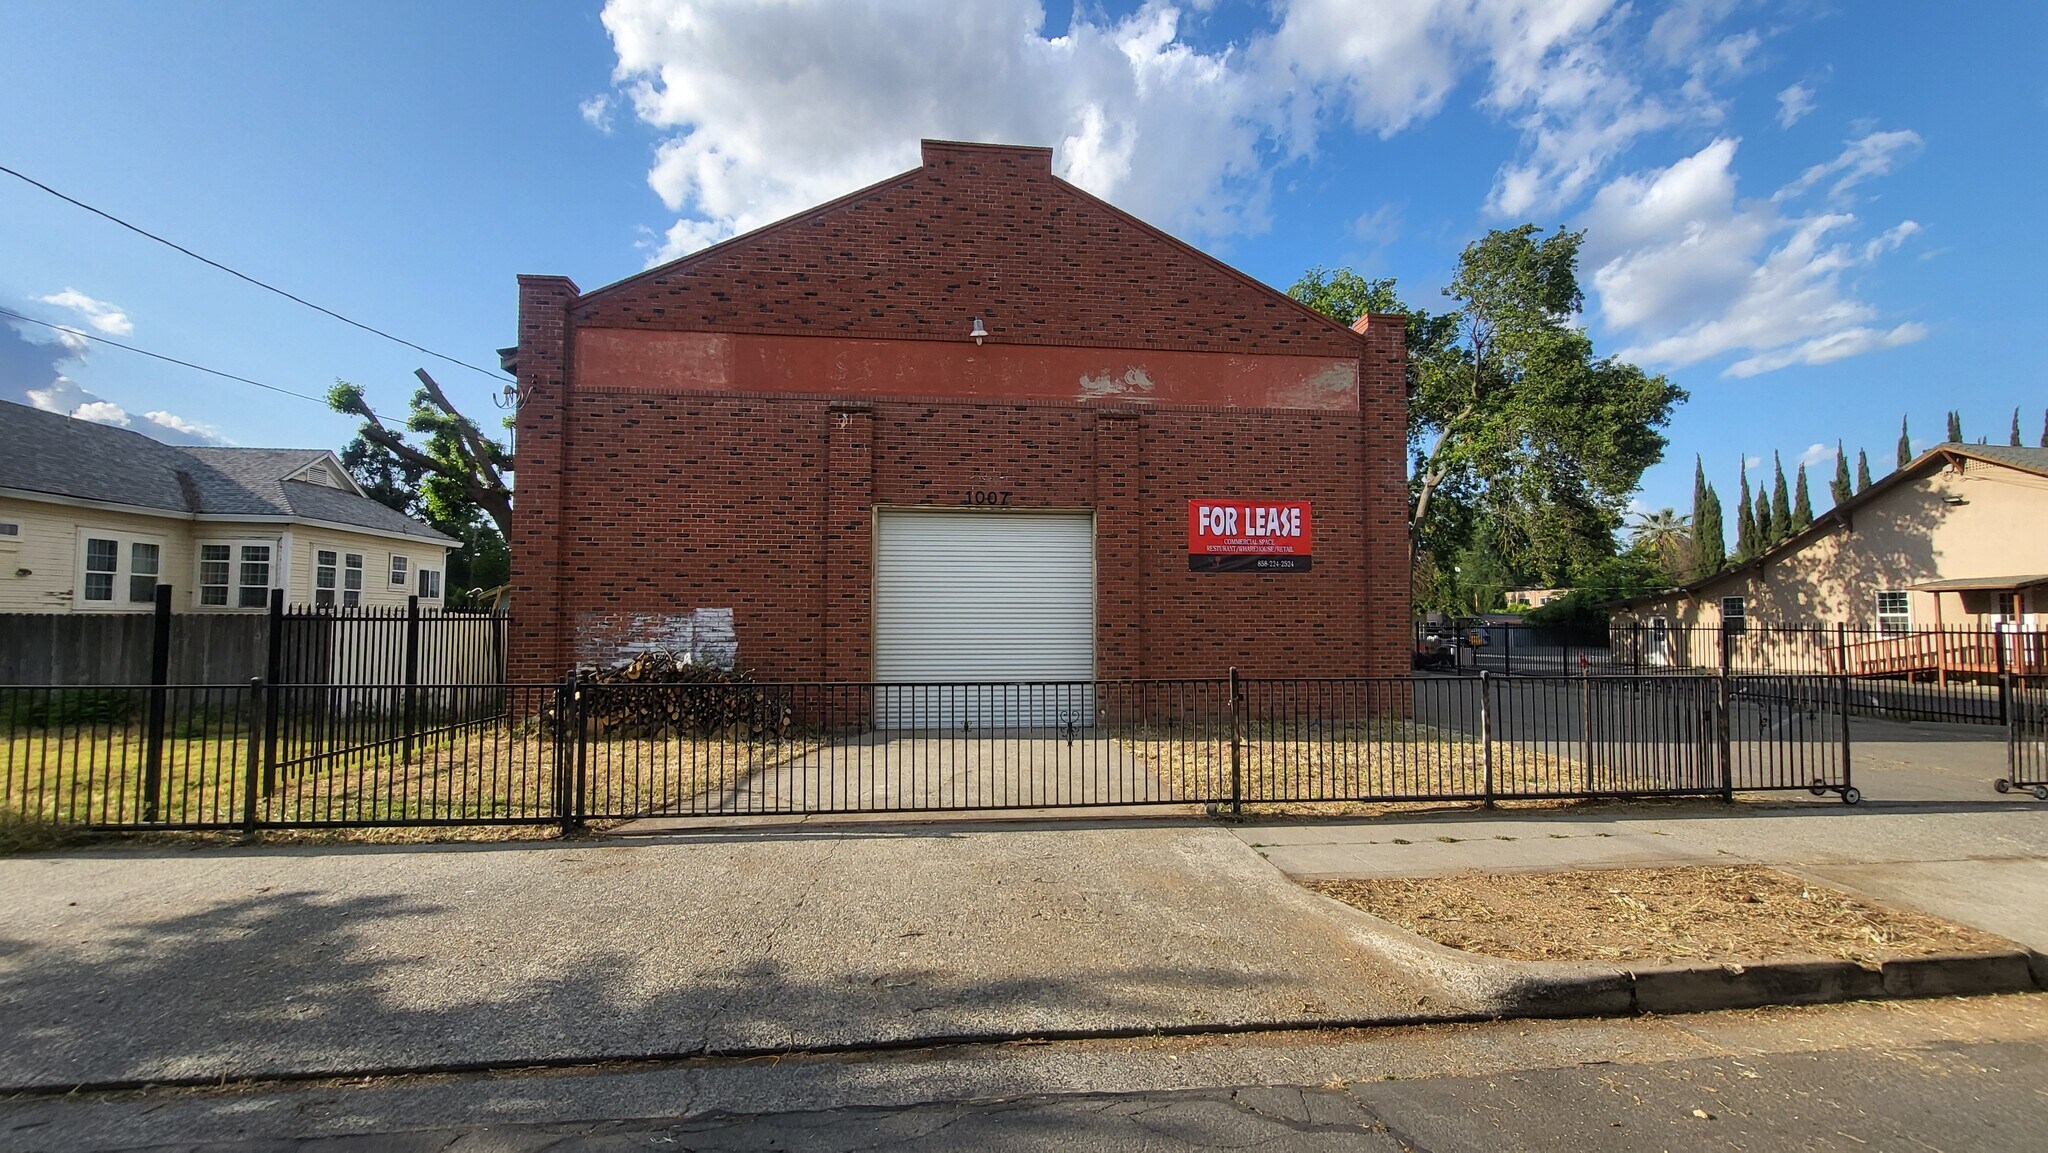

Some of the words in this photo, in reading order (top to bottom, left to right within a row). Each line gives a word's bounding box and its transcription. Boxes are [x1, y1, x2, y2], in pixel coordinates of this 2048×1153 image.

[965, 490, 1013, 505] 1007
[1199, 506, 1238, 536] FOR
[1245, 507, 1301, 537] LEASE
[1258, 538, 1275, 546] SPACE
